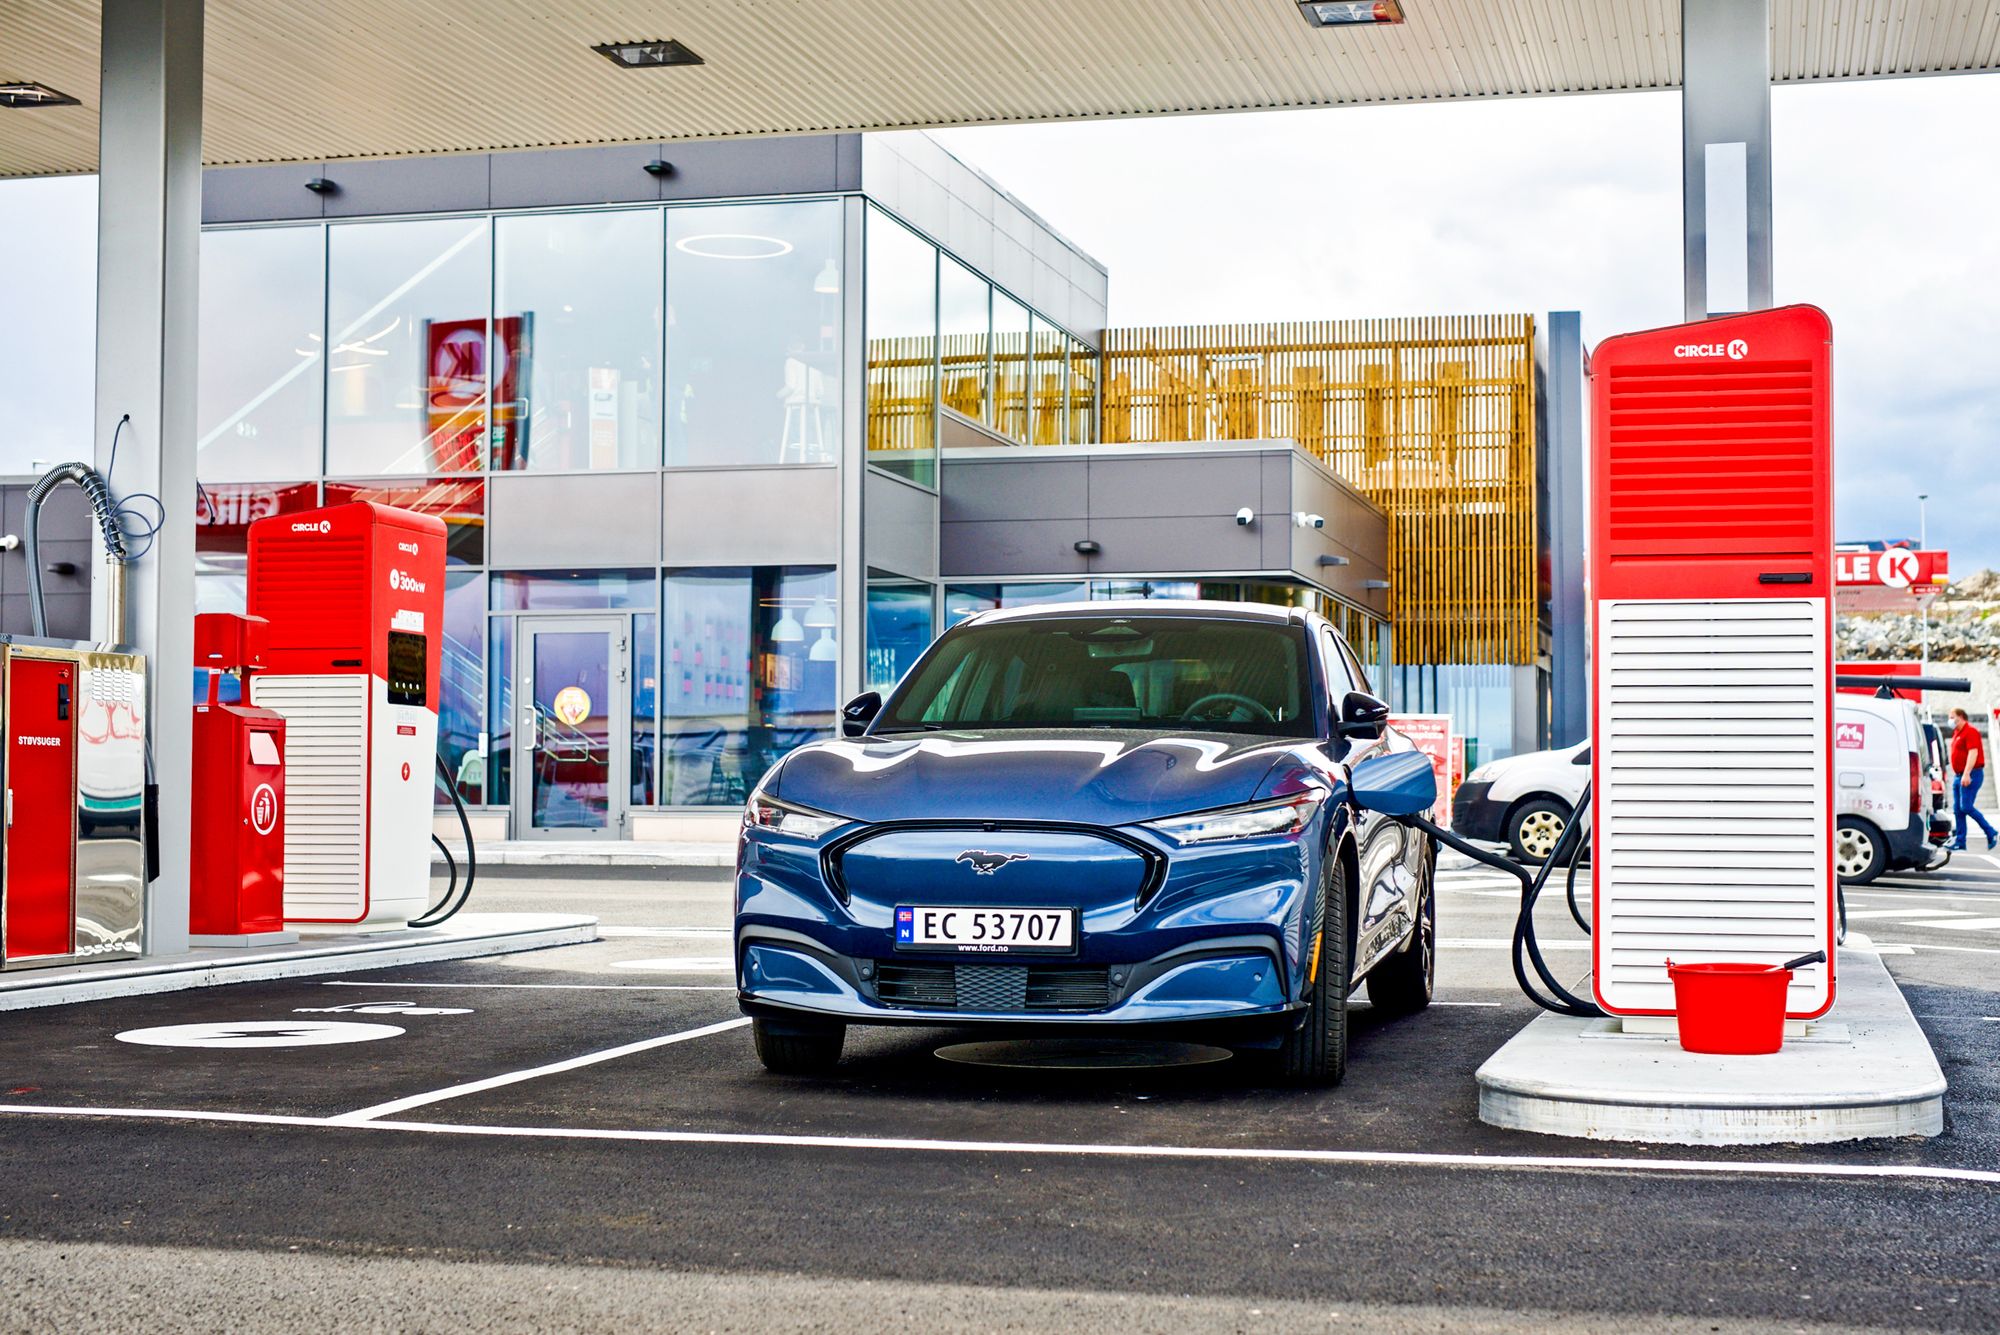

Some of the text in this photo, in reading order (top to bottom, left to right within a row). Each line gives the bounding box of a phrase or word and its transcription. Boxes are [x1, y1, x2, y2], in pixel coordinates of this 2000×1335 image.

[1674, 341, 1748, 360] CIRCLE K
[291, 520, 331, 533] CIRCLE K
[18, 735, 61, 747] STØVSUGER
[924, 912, 1062, 941] EC 53707
[901, 929, 909, 938] N
[958, 944, 1009, 953] www.ford.no
